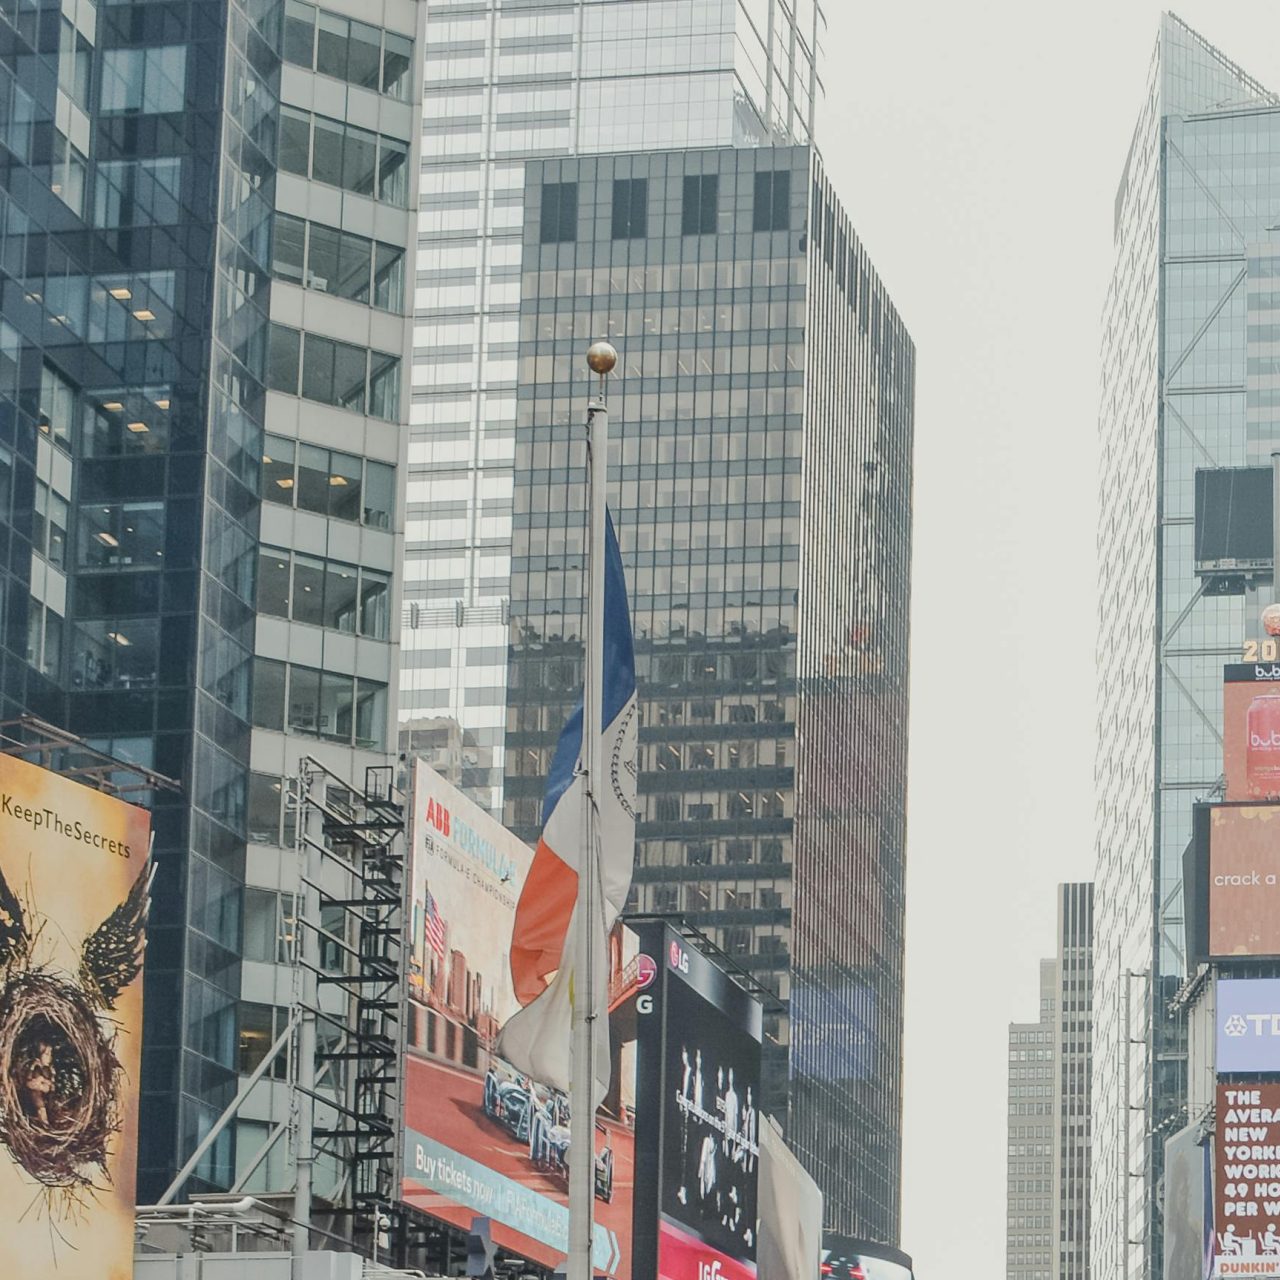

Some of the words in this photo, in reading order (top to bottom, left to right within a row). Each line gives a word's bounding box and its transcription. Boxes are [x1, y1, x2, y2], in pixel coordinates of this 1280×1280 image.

[426, 796, 450, 837] ABB
[2, 793, 131, 859] KeepTheSecrets
[1214, 869, 1260, 887] crack
[1266, 873, 1277, 886] a
[678, 948, 688, 974] LG
[1224, 1090, 1261, 1106] THE
[1224, 1127, 1268, 1142] NEW
[416, 1144, 436, 1180] Buy
[436, 1155, 472, 1194] tickets
[472, 1176, 494, 1204] now
[1224, 1182, 1249, 1198] 49
[1224, 1201, 1258, 1217] PER
[1220, 1262, 1279, 1273] DUNKIN'
